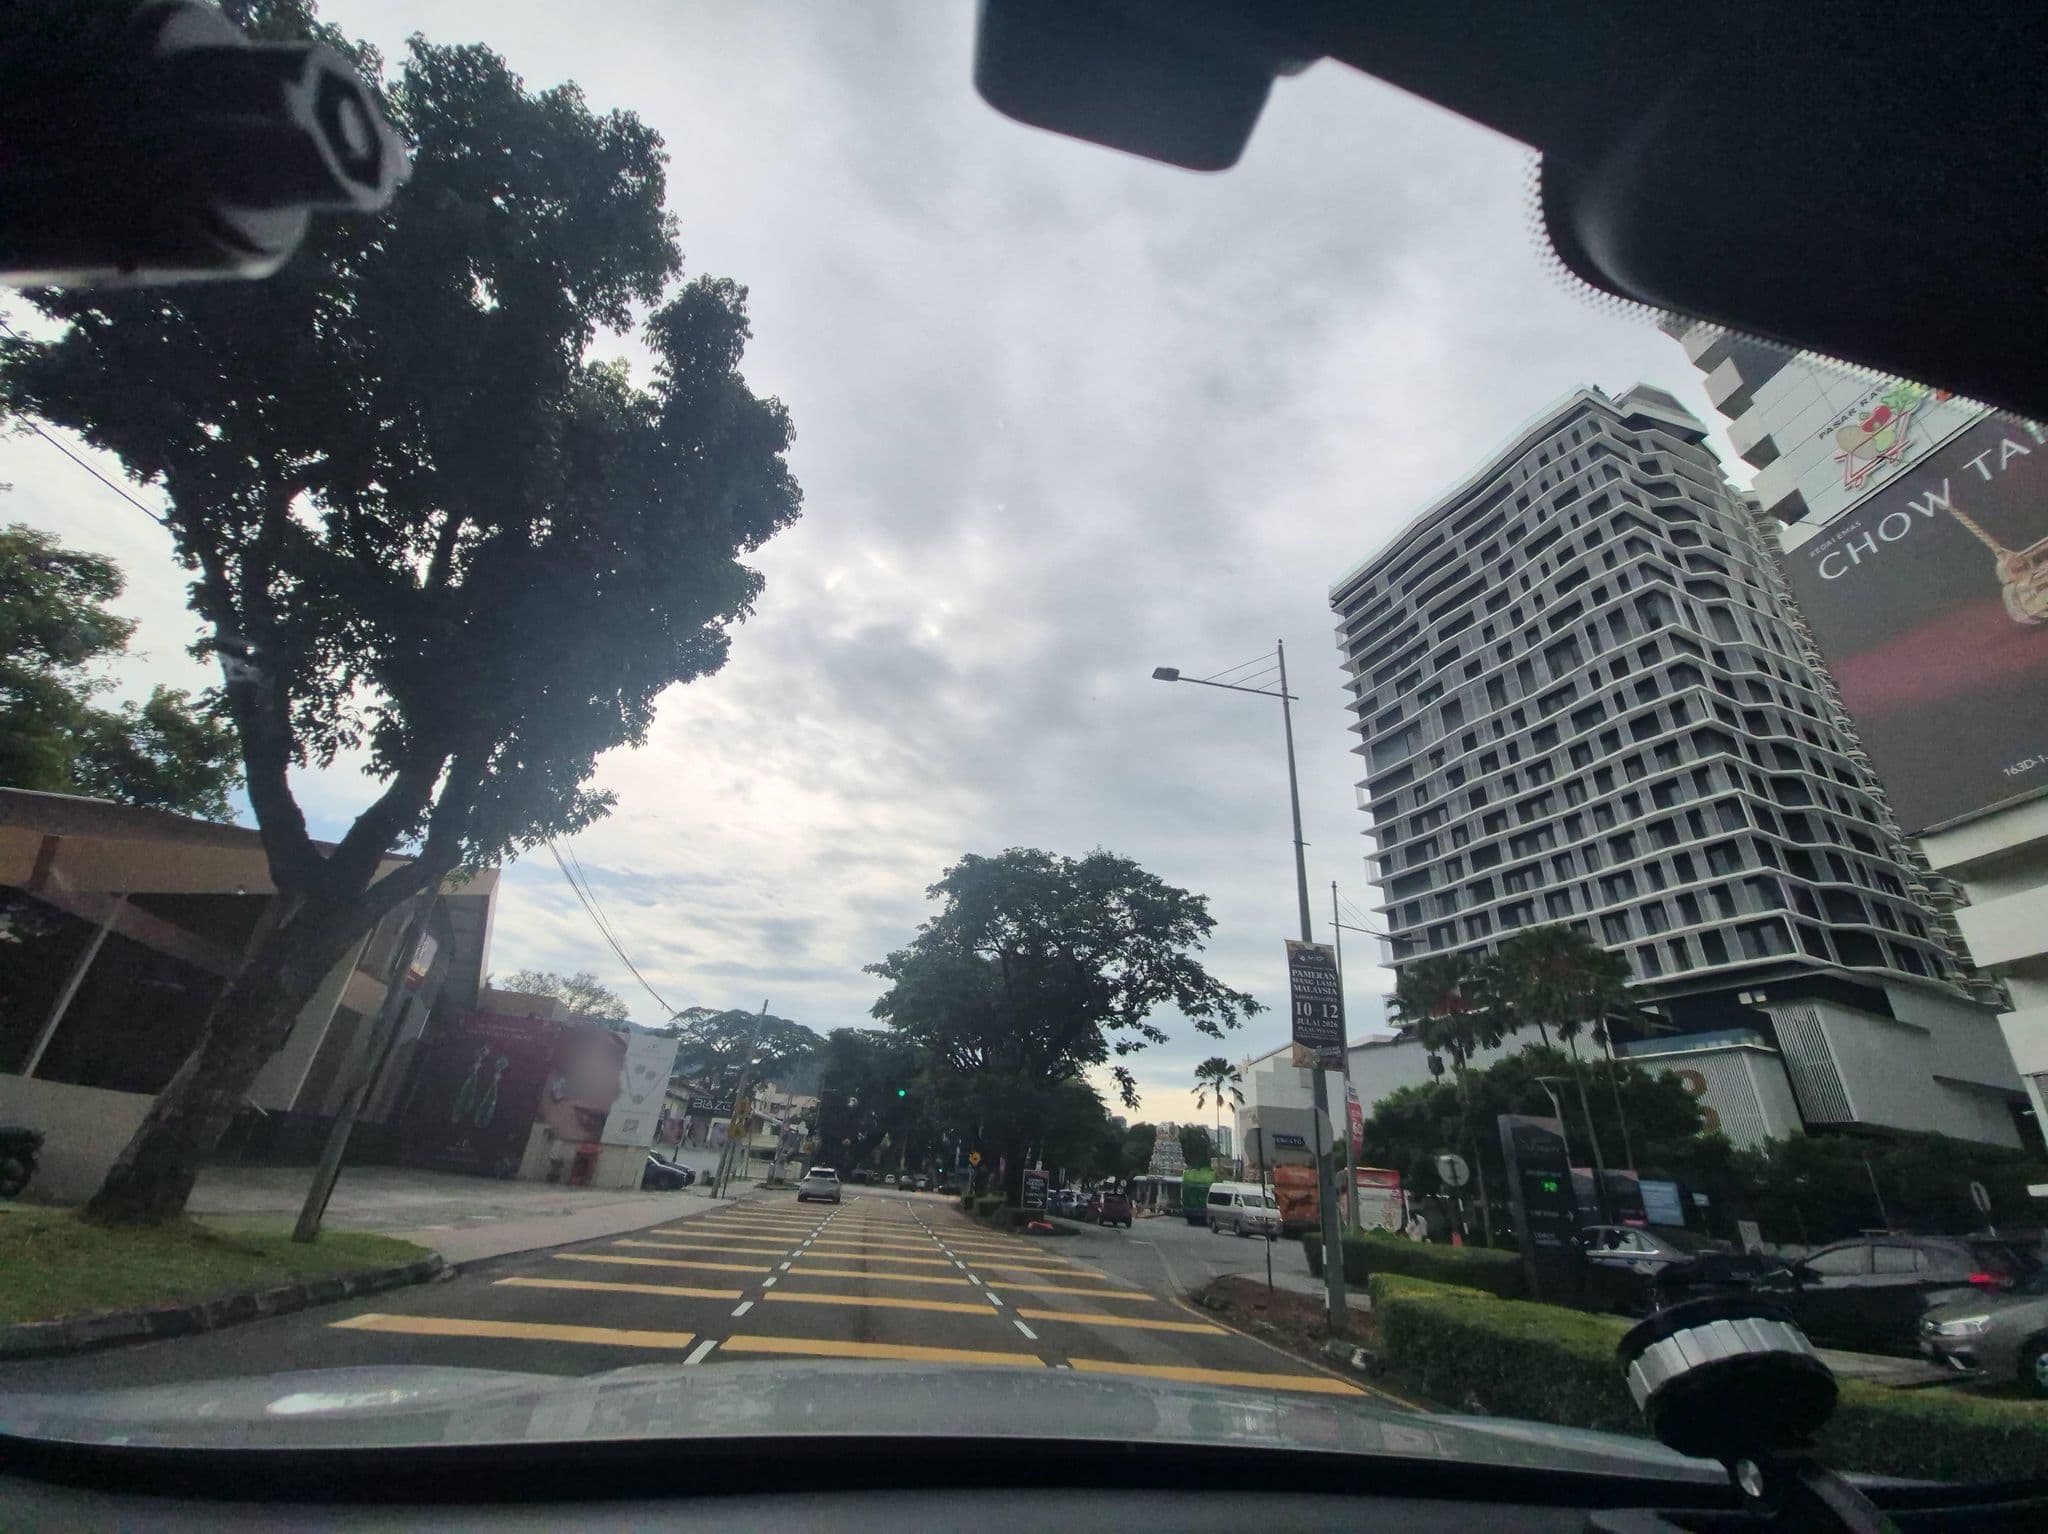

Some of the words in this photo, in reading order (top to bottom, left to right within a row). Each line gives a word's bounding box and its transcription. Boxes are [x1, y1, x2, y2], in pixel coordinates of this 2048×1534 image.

[1819, 408, 1857, 440] PASAR
[1818, 477, 1951, 580] CHOW
[1293, 984, 1338, 996] MALAYSIA
[1295, 1001, 1312, 1017] 10
[1322, 1004, 1339, 1019] 12
